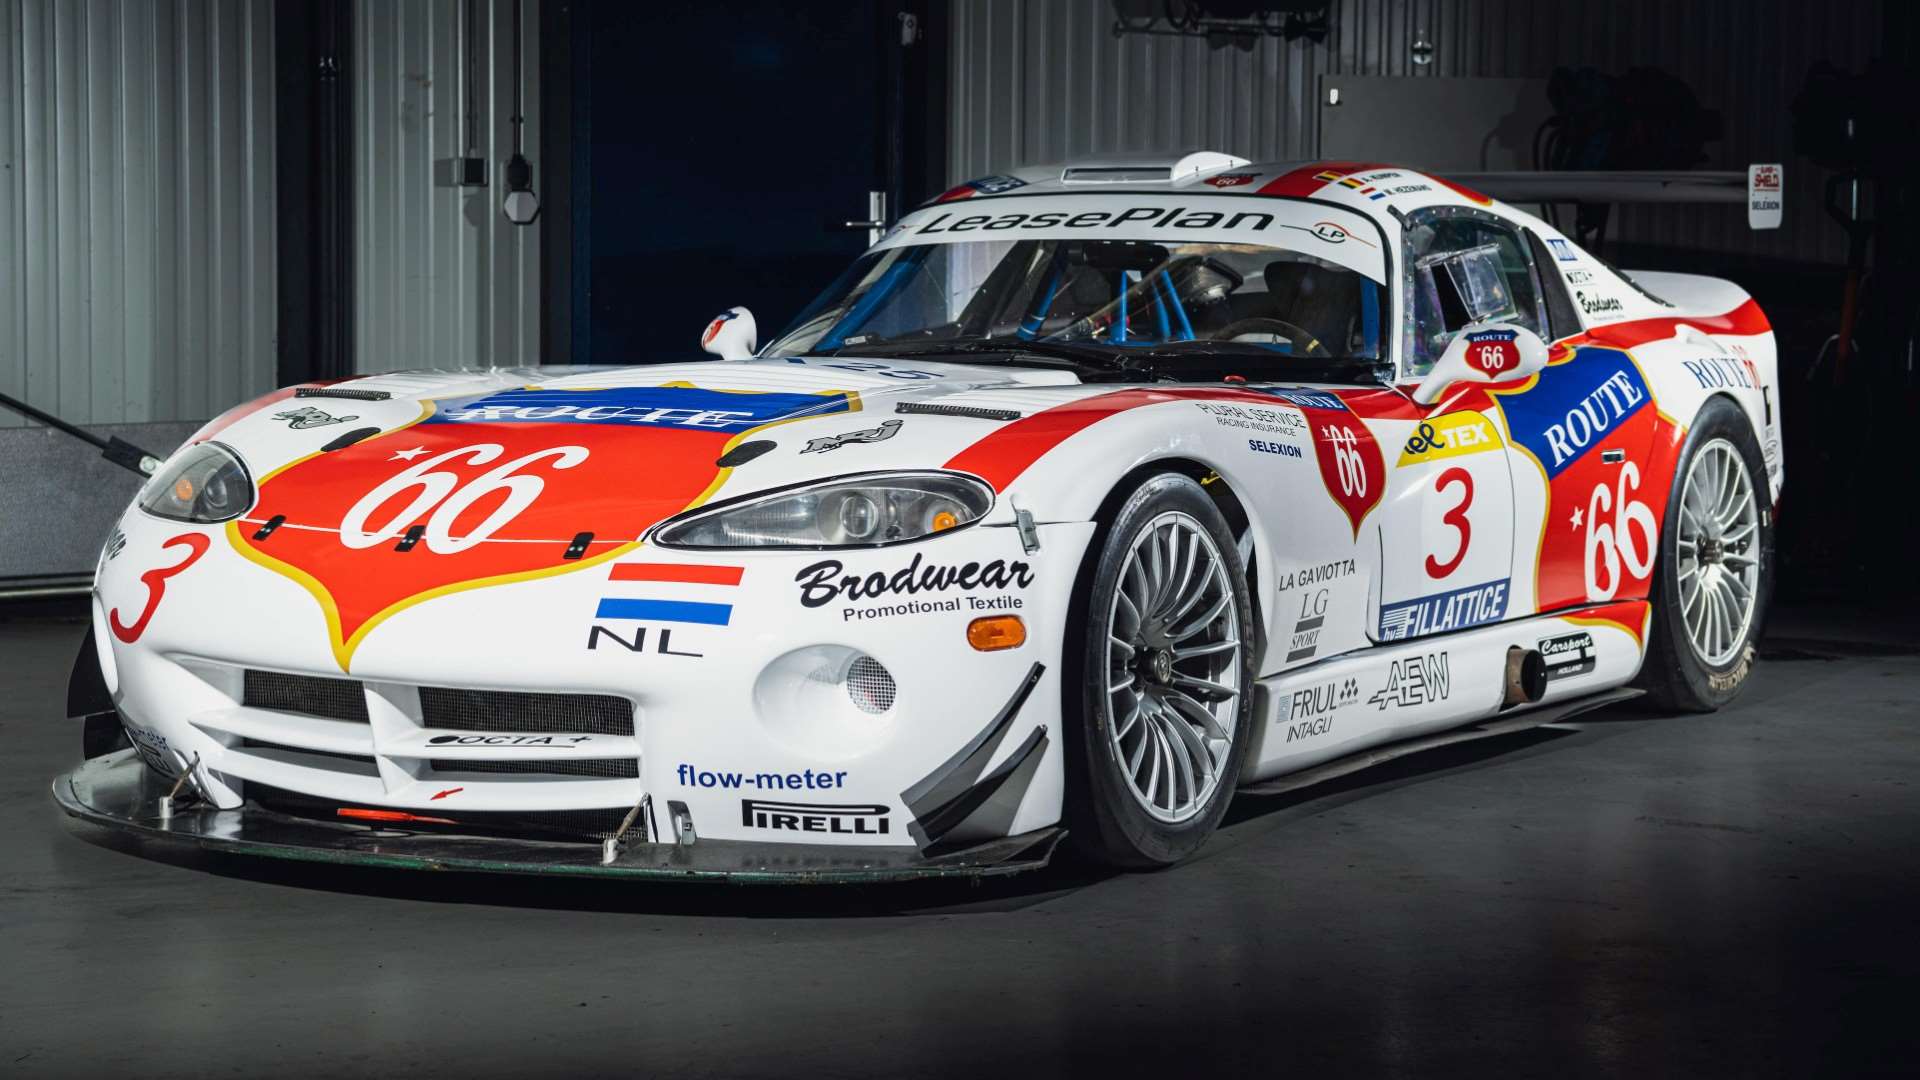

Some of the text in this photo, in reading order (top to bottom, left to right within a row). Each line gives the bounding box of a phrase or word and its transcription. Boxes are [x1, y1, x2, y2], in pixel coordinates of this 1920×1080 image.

[914, 207, 1275, 235] LeasePlan
[1318, 226, 1345, 238] LP
[1473, 334, 1512, 342] ROUTE
[1481, 345, 1504, 369] 66
[1682, 359, 1751, 390] ROUTE
[448, 404, 755, 428] ROUTE
[1195, 403, 1306, 429] PLURAL SERVICE
[1216, 416, 1297, 437] RACING INSURANCE
[1543, 369, 1644, 467] ROUTE
[1248, 439, 1303, 459] SELEXION
[1440, 421, 1490, 449] TEX
[1329, 424, 1367, 498] 66
[339, 443, 590, 556] 66
[1425, 466, 1474, 580] 3
[1585, 461, 1658, 602] 66
[109, 532, 211, 644] 3
[795, 553, 1035, 608] Brodwear
[1279, 558, 1355, 592] LA GAVIOTTA
[842, 594, 1024, 622] Promotional Textile
[1299, 588, 1329, 620] LG
[1402, 583, 1506, 639] FILLATTICE
[587, 625, 704, 658] NL
[1289, 629, 1321, 650] SPORT
[1541, 635, 1591, 655] Carsport
[1367, 651, 1450, 711] AEW
[1290, 682, 1337, 721] FRIUL
[1286, 715, 1333, 743] INTAGLI
[676, 764, 849, 790] flow-meter
[741, 799, 891, 834] PIRELLI
